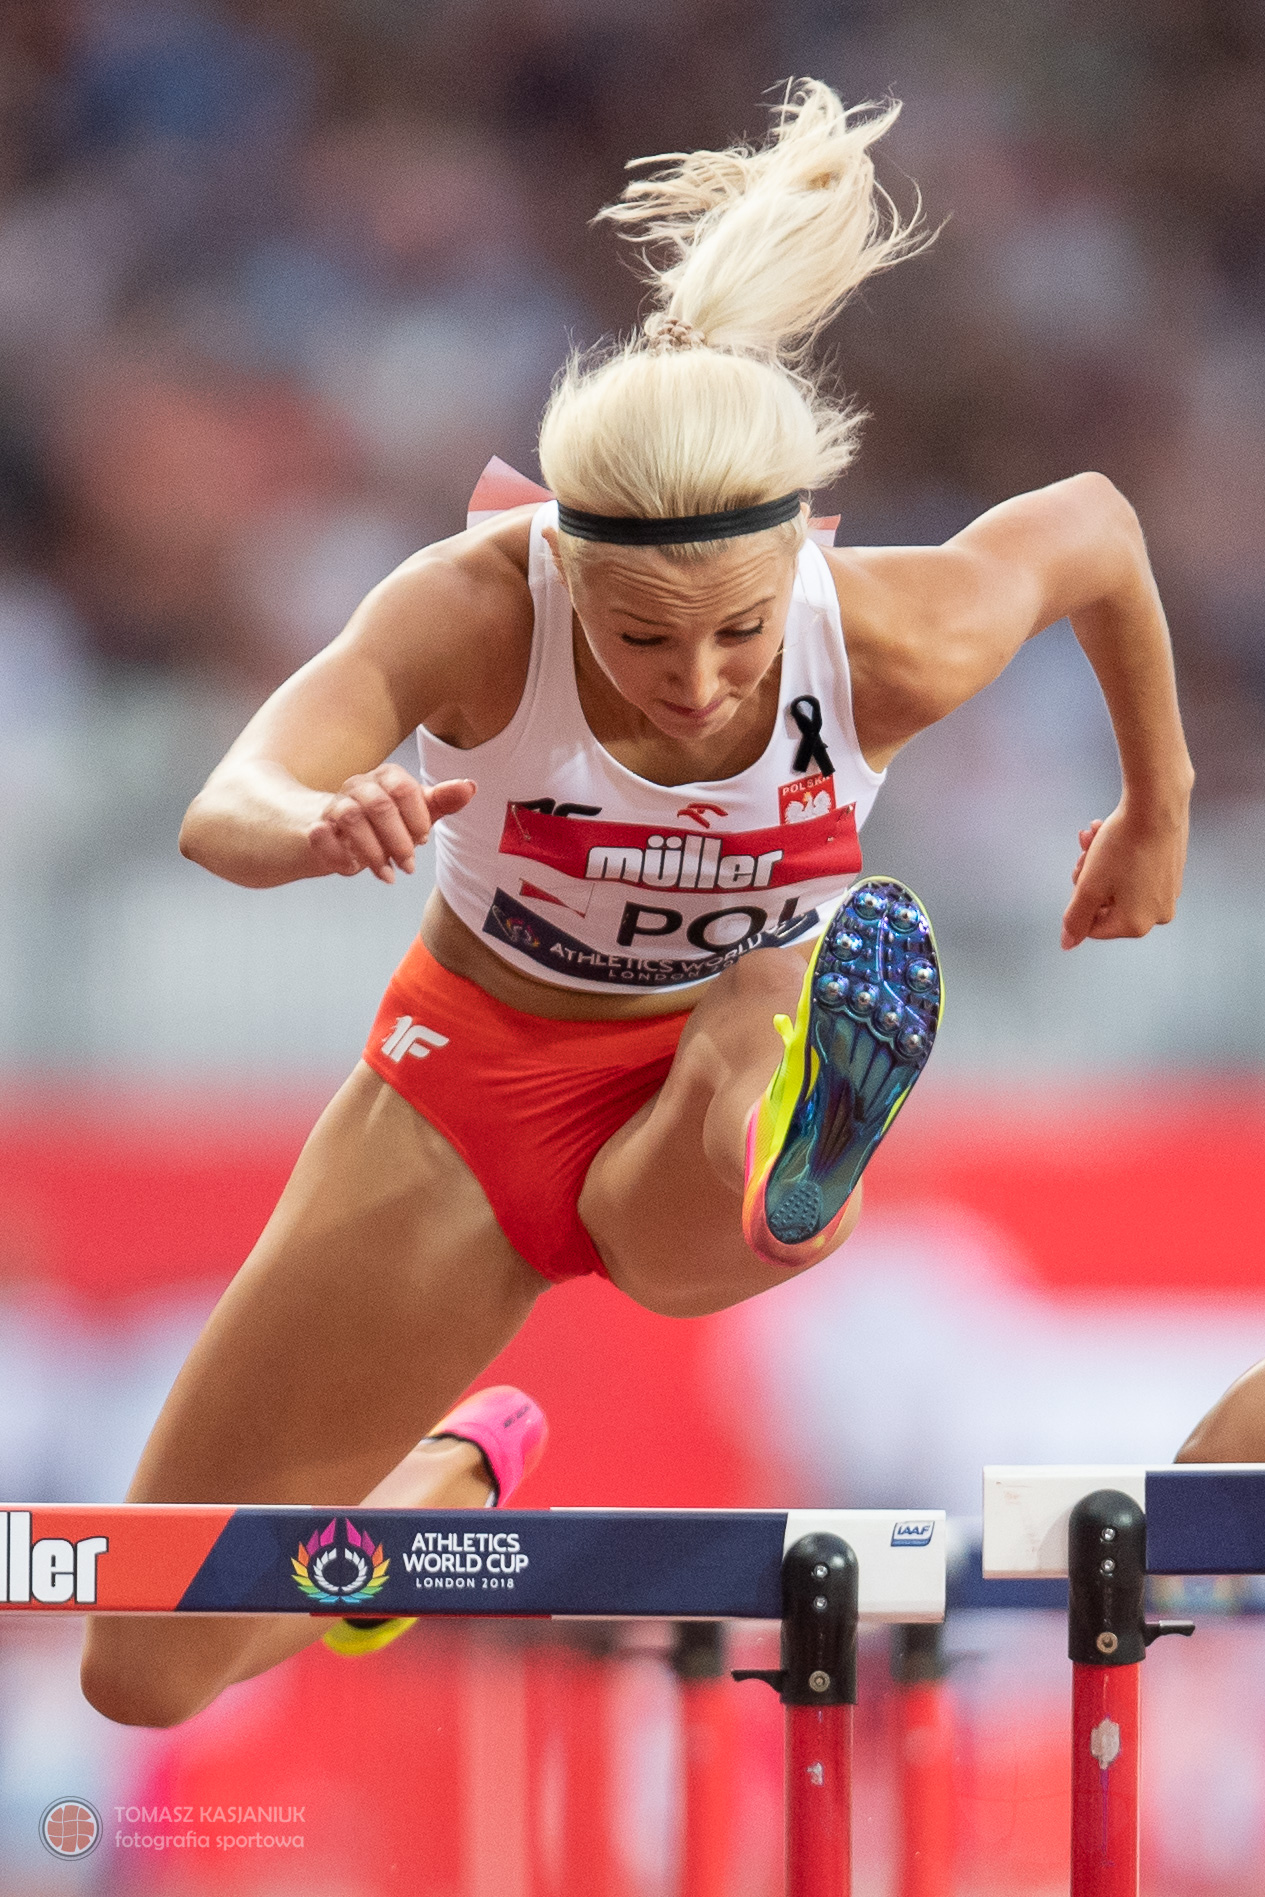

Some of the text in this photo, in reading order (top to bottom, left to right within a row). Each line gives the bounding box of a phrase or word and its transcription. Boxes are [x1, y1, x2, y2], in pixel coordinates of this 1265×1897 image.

[782, 776, 830, 796] POLSK
[585, 834, 784, 890] müller
[549, 942, 674, 973] ATHLETICS
[608, 969, 700, 980] LONDON
[897, 1525, 931, 1535] IAAF
[411, 1532, 521, 1552] ATHLETICS
[402, 1553, 529, 1573] WORLD CUP
[415, 1577, 515, 1589] LONDON 2018
